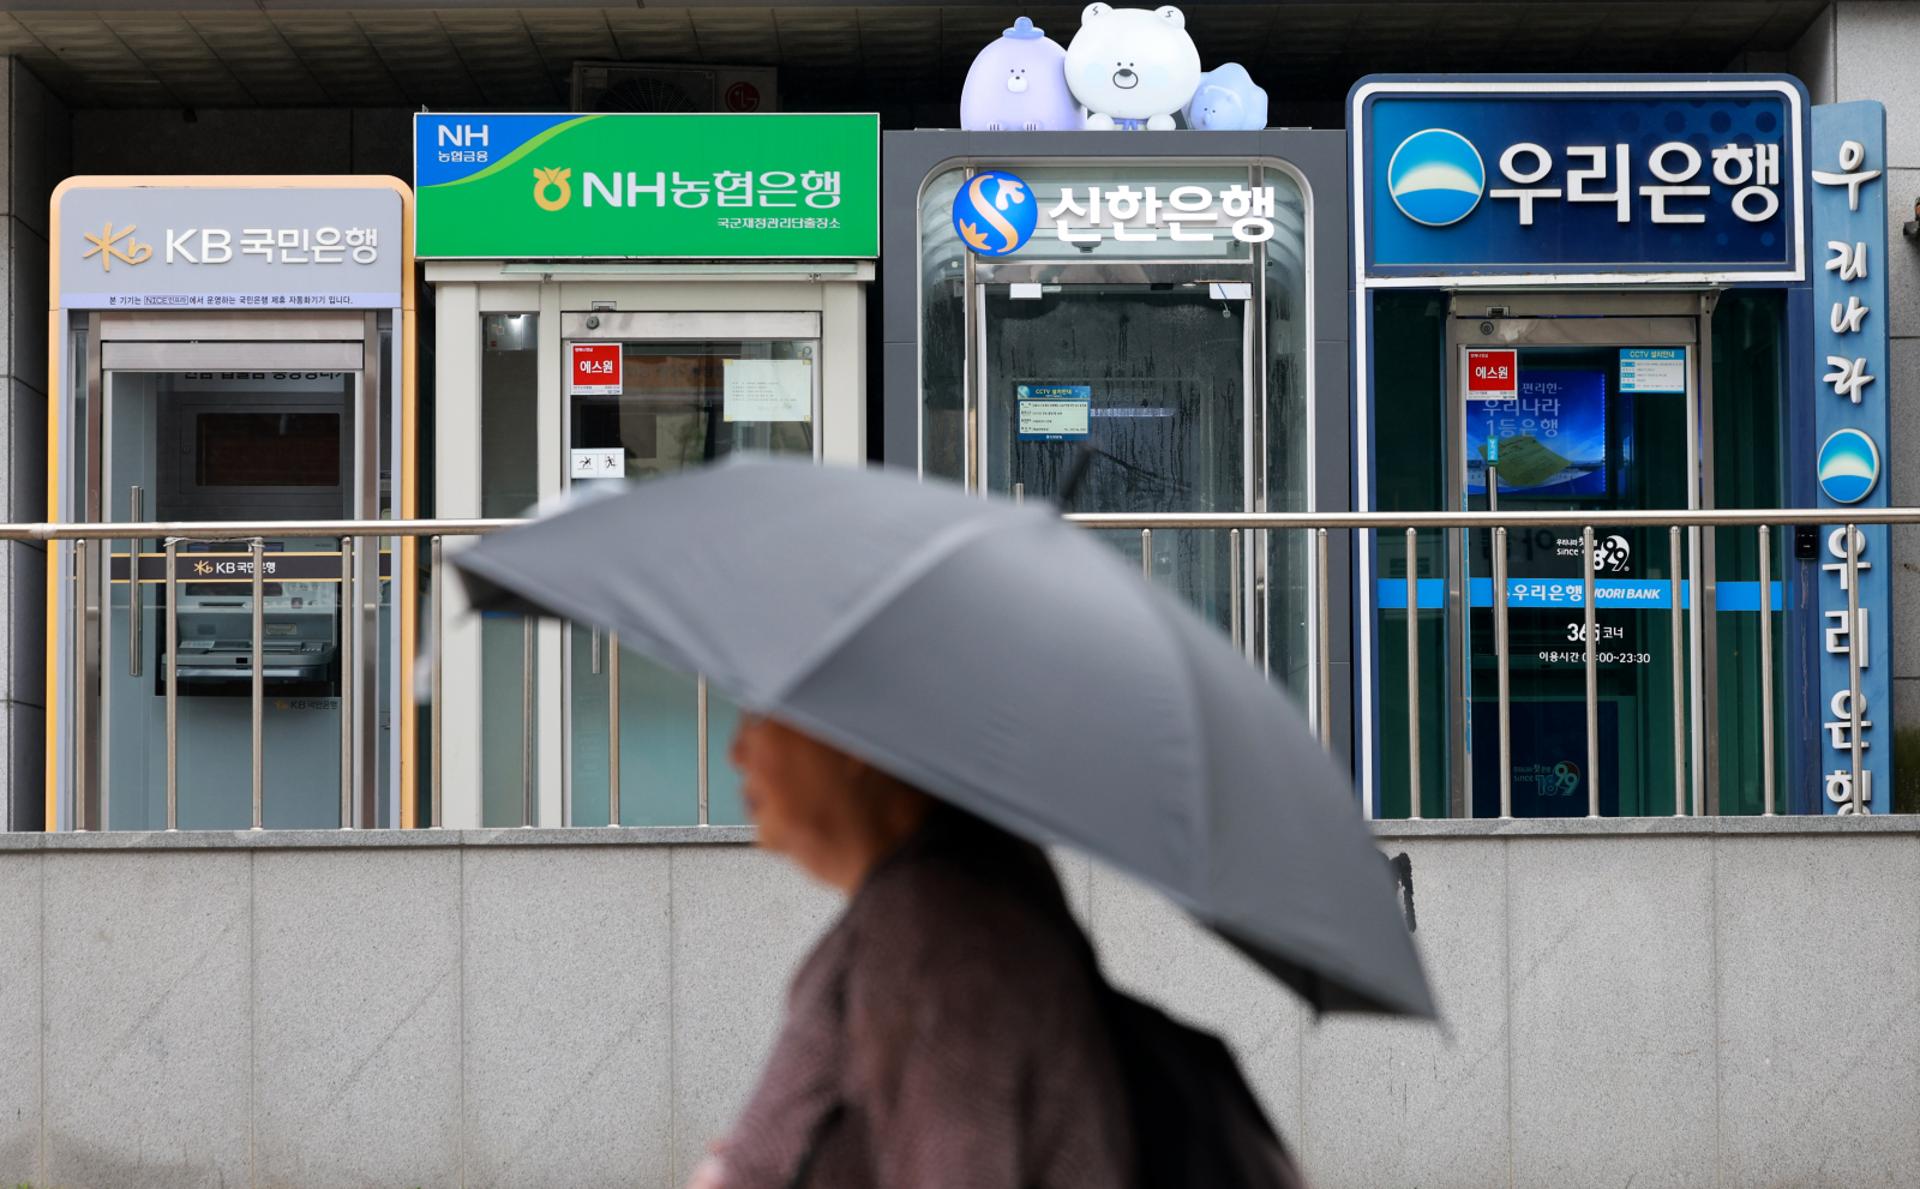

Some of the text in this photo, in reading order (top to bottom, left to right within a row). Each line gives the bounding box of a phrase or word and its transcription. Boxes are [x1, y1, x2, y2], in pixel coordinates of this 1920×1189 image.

[438, 124, 489, 147] NH
[438, 150, 489, 163] 농협금융
[1489, 141, 1780, 226] 우리은행
[1048, 184, 1276, 243] 신한은행
[579, 360, 614, 375] 에스원
[1475, 366, 1509, 379] 에스원
[1482, 398, 1561, 417] 우리나라
[1486, 418, 1559, 439] 1등은행
[1556, 548, 1579, 556] since
[1512, 584, 1661, 602] 우리은행 OORI BANK
[1602, 626, 1625, 639] 코너
[1539, 651, 1651, 664] 이용시간 0:00~23:30
